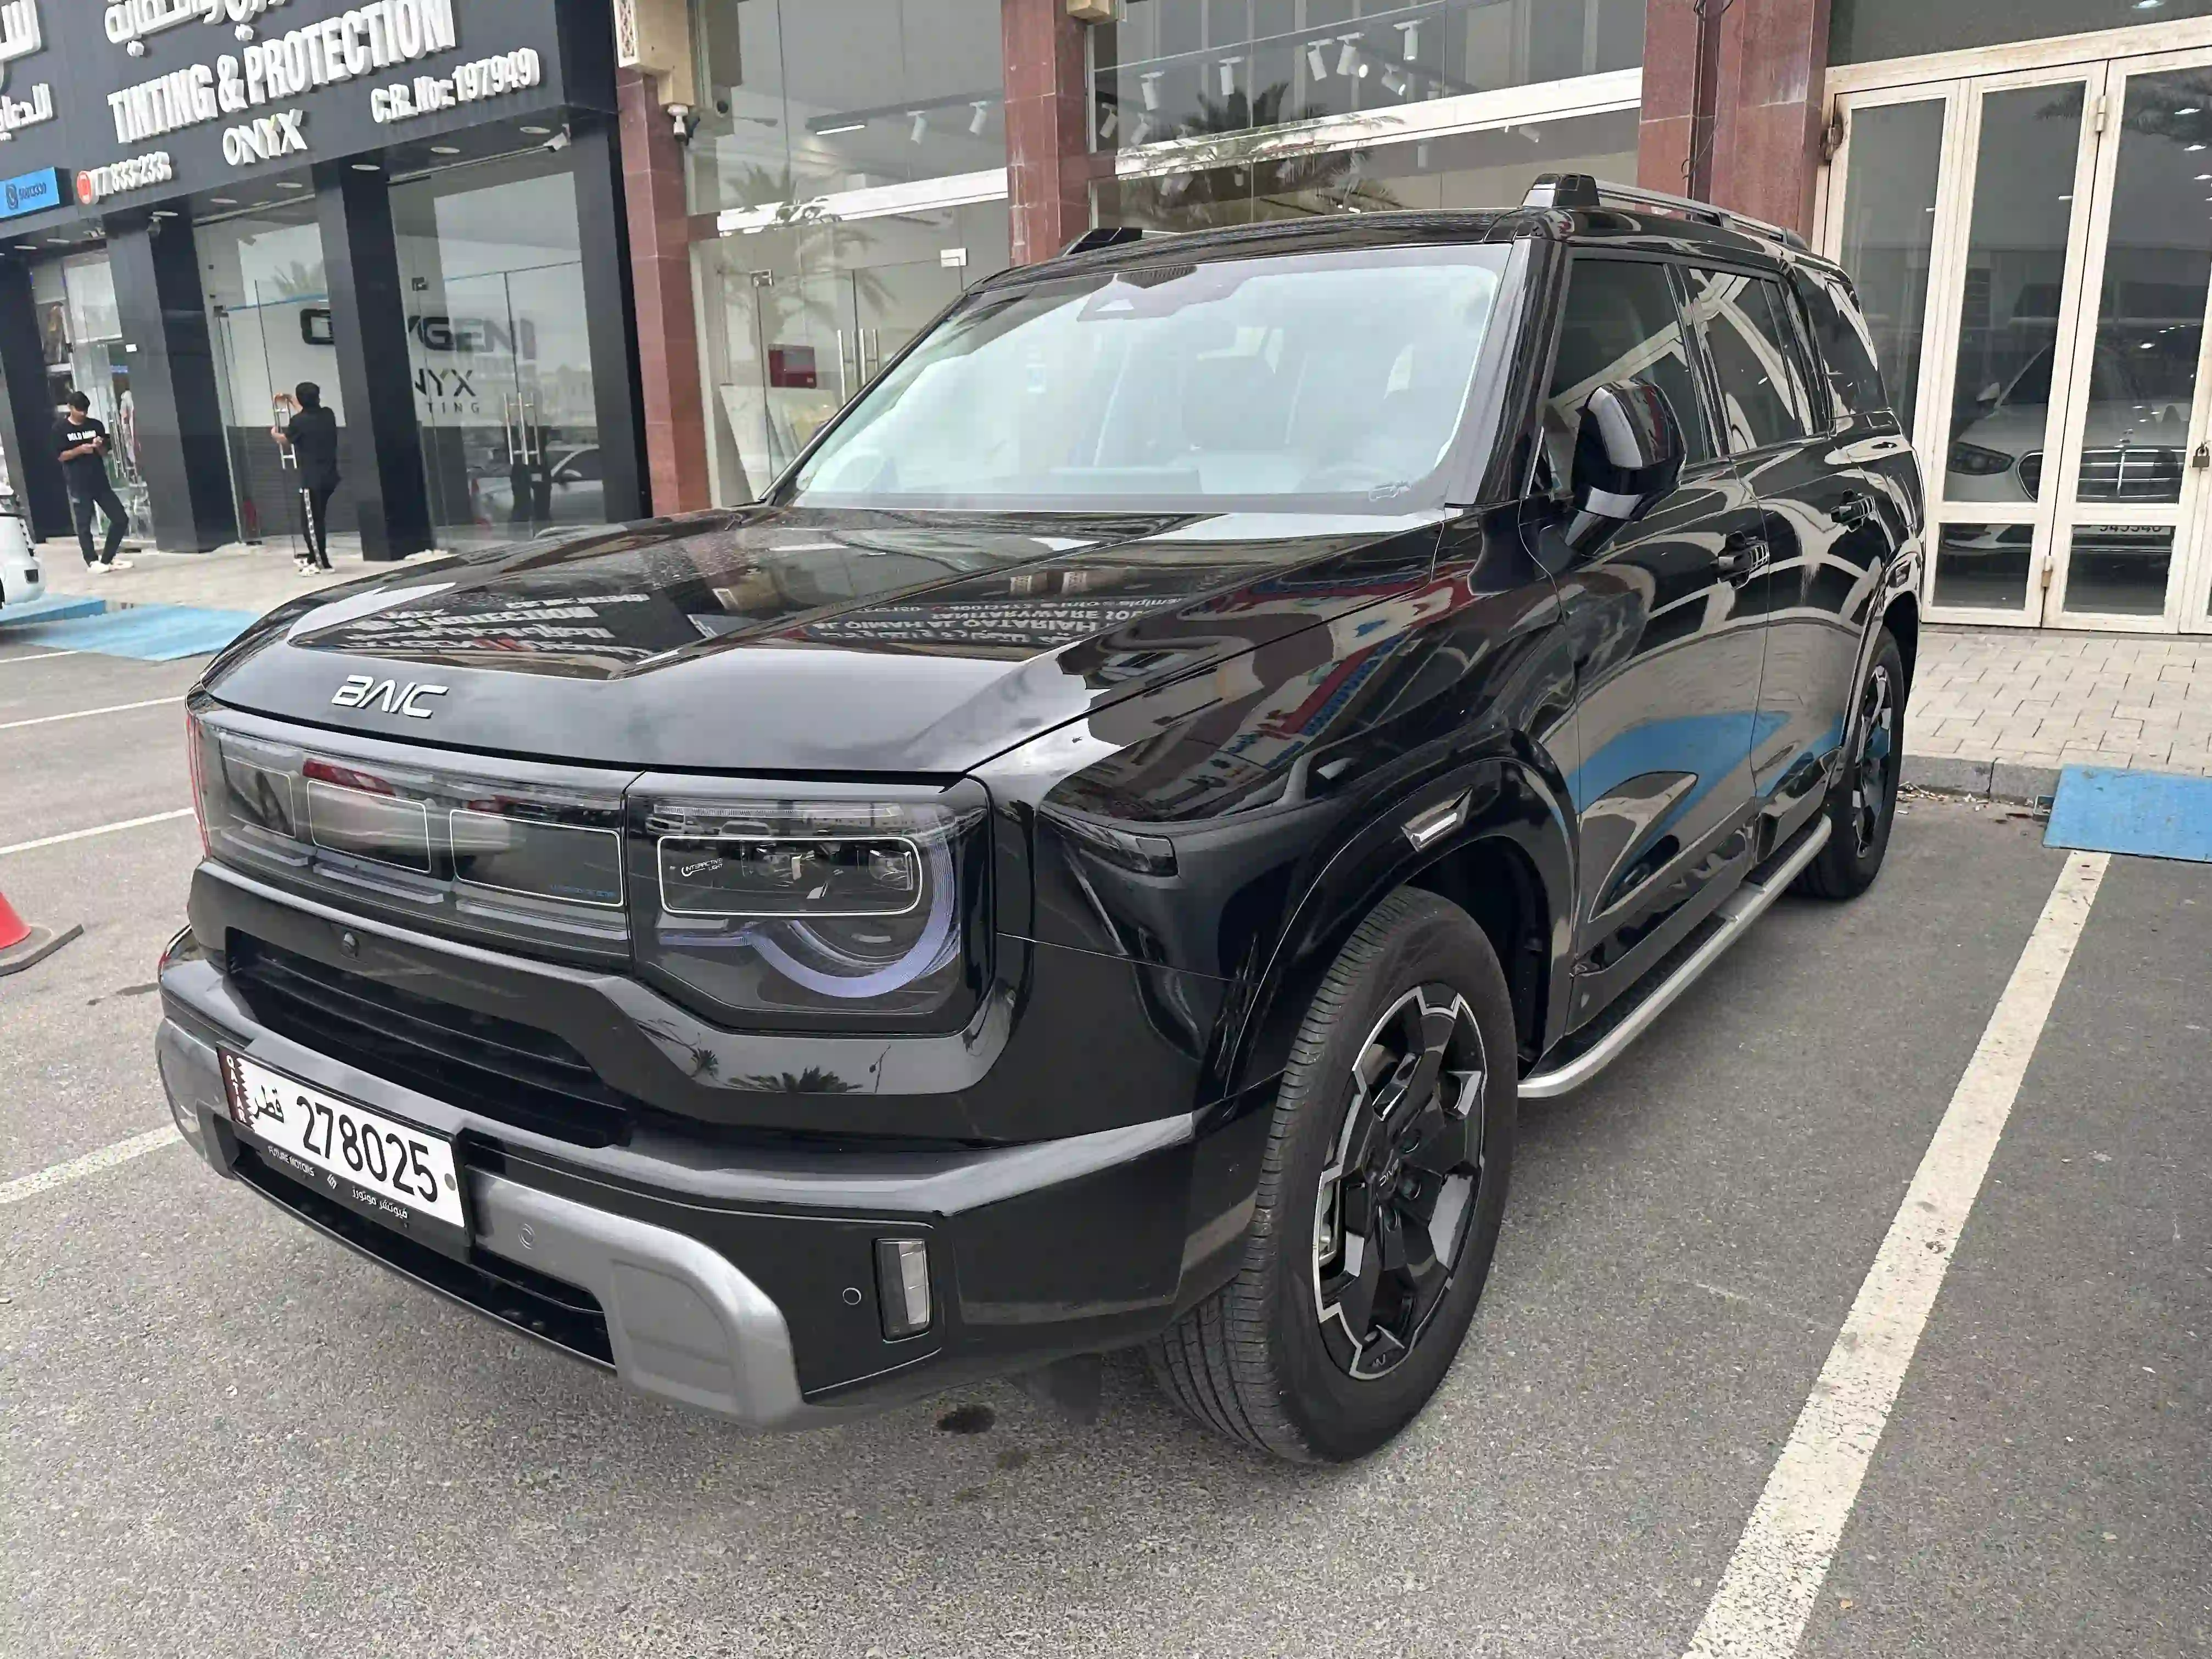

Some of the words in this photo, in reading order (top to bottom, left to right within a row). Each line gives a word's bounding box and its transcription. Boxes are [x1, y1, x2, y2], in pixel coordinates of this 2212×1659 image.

[107, 64, 219, 143] TINTING
[217, 54, 248, 113] &
[243, 0, 456, 104] PROTECTION
[451, 48, 540, 101] 197949
[222, 109, 308, 165] ONYX
[415, 368, 477, 397] NYX
[331, 674, 449, 719] BAIC
[226, 1054, 247, 1124] QATAR
[250, 1085, 284, 1124] قطر
[267, 1146, 290, 1164] FUTURE
[288, 1157, 315, 1177] MOTORS
[297, 1096, 438, 1203] 278025
